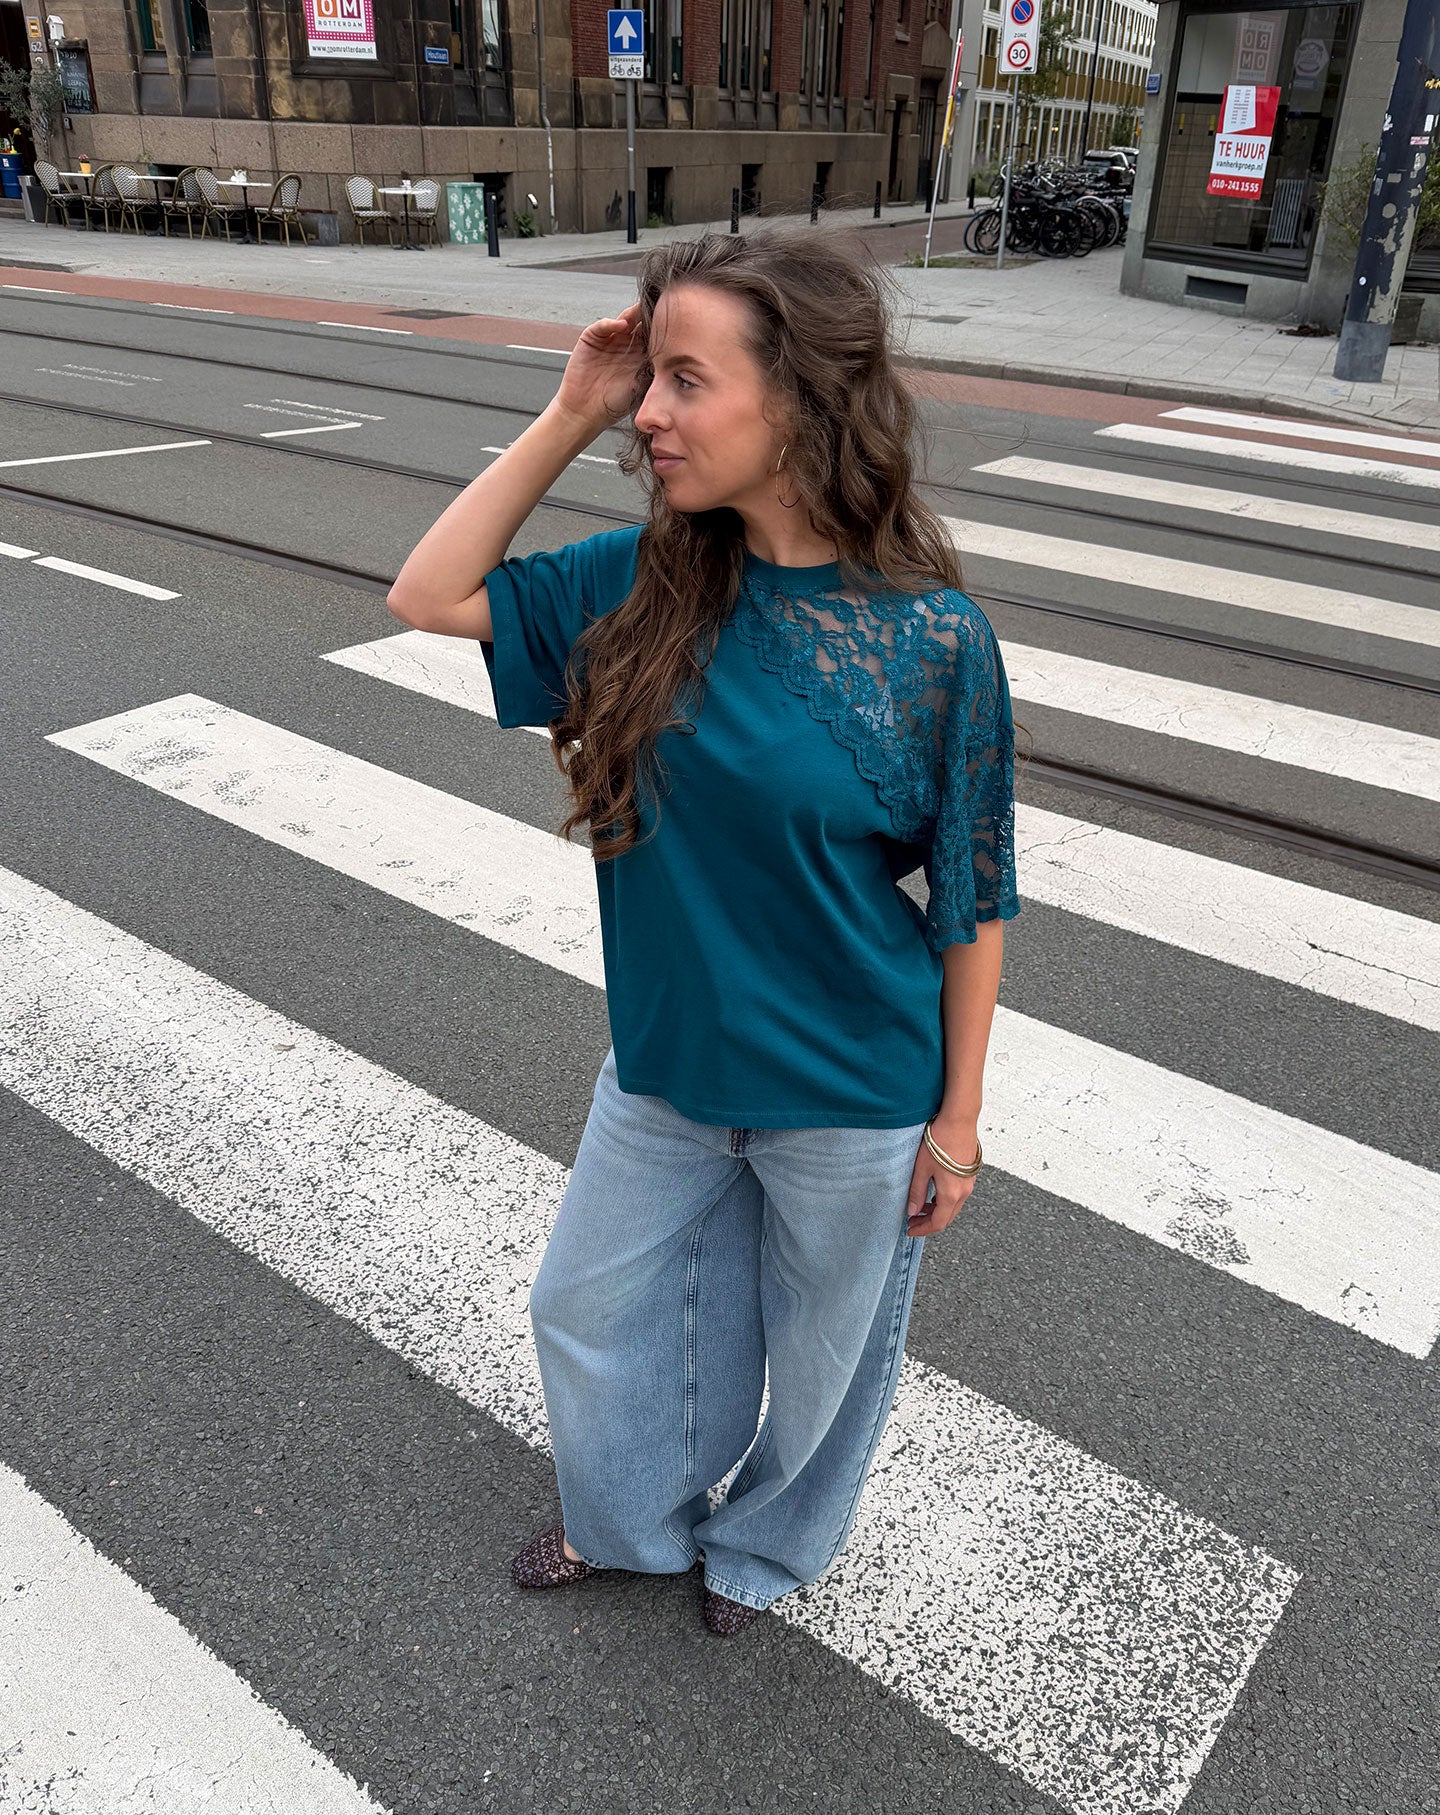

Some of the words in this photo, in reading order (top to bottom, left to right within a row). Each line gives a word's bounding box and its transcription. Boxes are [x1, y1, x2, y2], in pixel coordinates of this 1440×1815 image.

[1012, 49, 1027, 59] 30
[1219, 141, 1233, 157] TE
[1235, 142, 1266, 160] HUUR
[1216, 160, 1264, 171] vanherkgroep.nl
